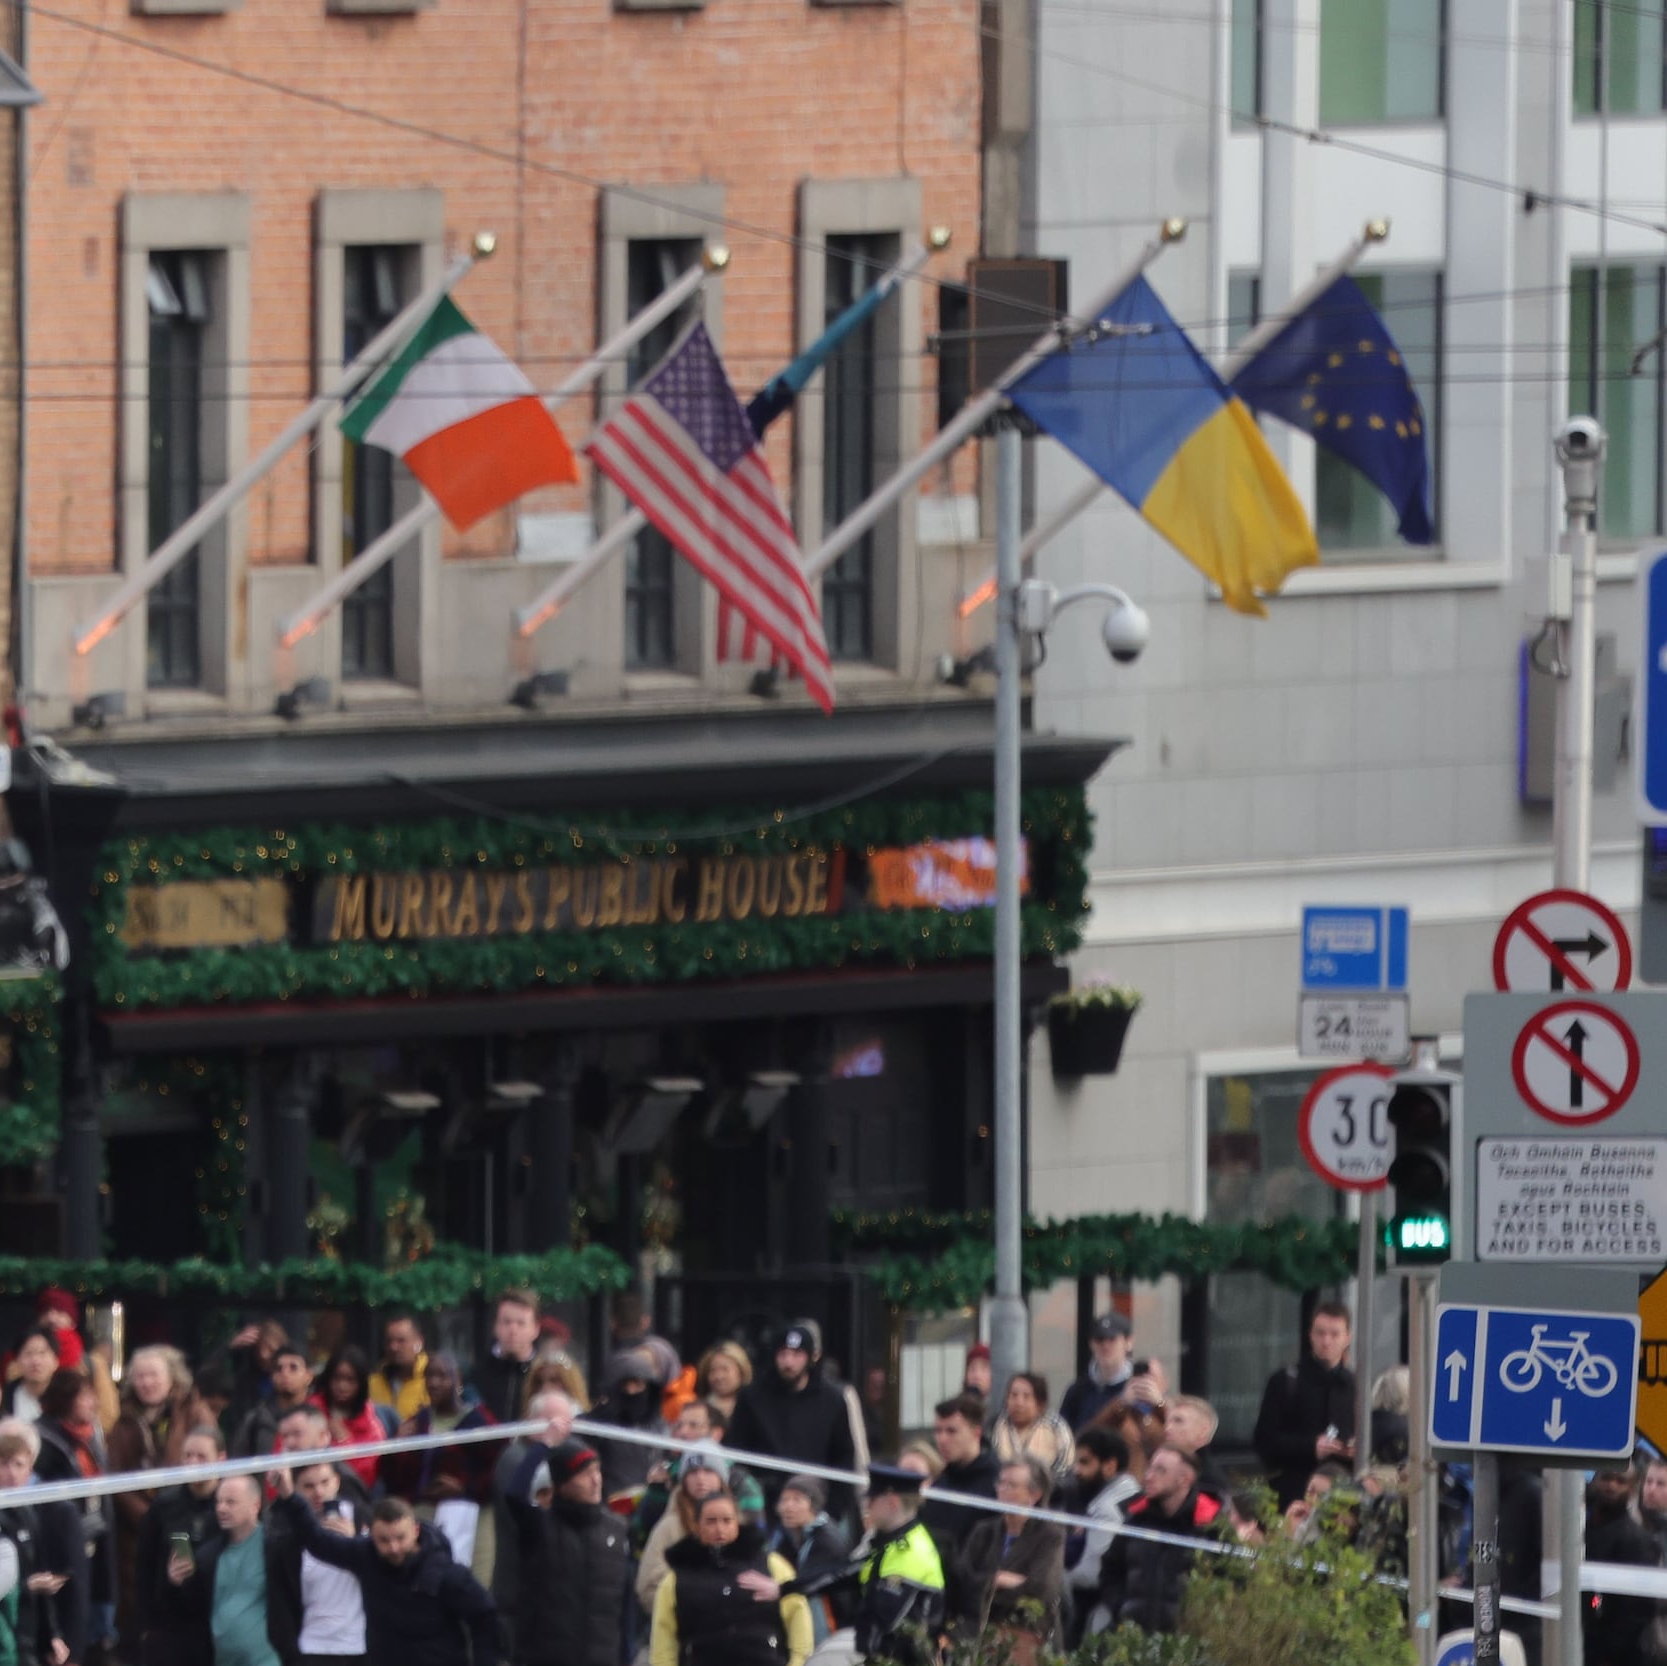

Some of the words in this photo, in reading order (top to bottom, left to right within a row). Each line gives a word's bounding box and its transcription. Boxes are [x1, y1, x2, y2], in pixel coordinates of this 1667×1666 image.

[543, 857, 686, 930] PUBLIC
[694, 854, 831, 923] HOUSE
[1315, 1016, 1350, 1039] 24
[1498, 1203, 1571, 1217] EXCEPT
[1563, 1221, 1657, 1236] BICYCLES
[1489, 1239, 1530, 1254] AND
[1536, 1239, 1574, 1254] FOR
[1582, 1239, 1662, 1254] ACCESS
